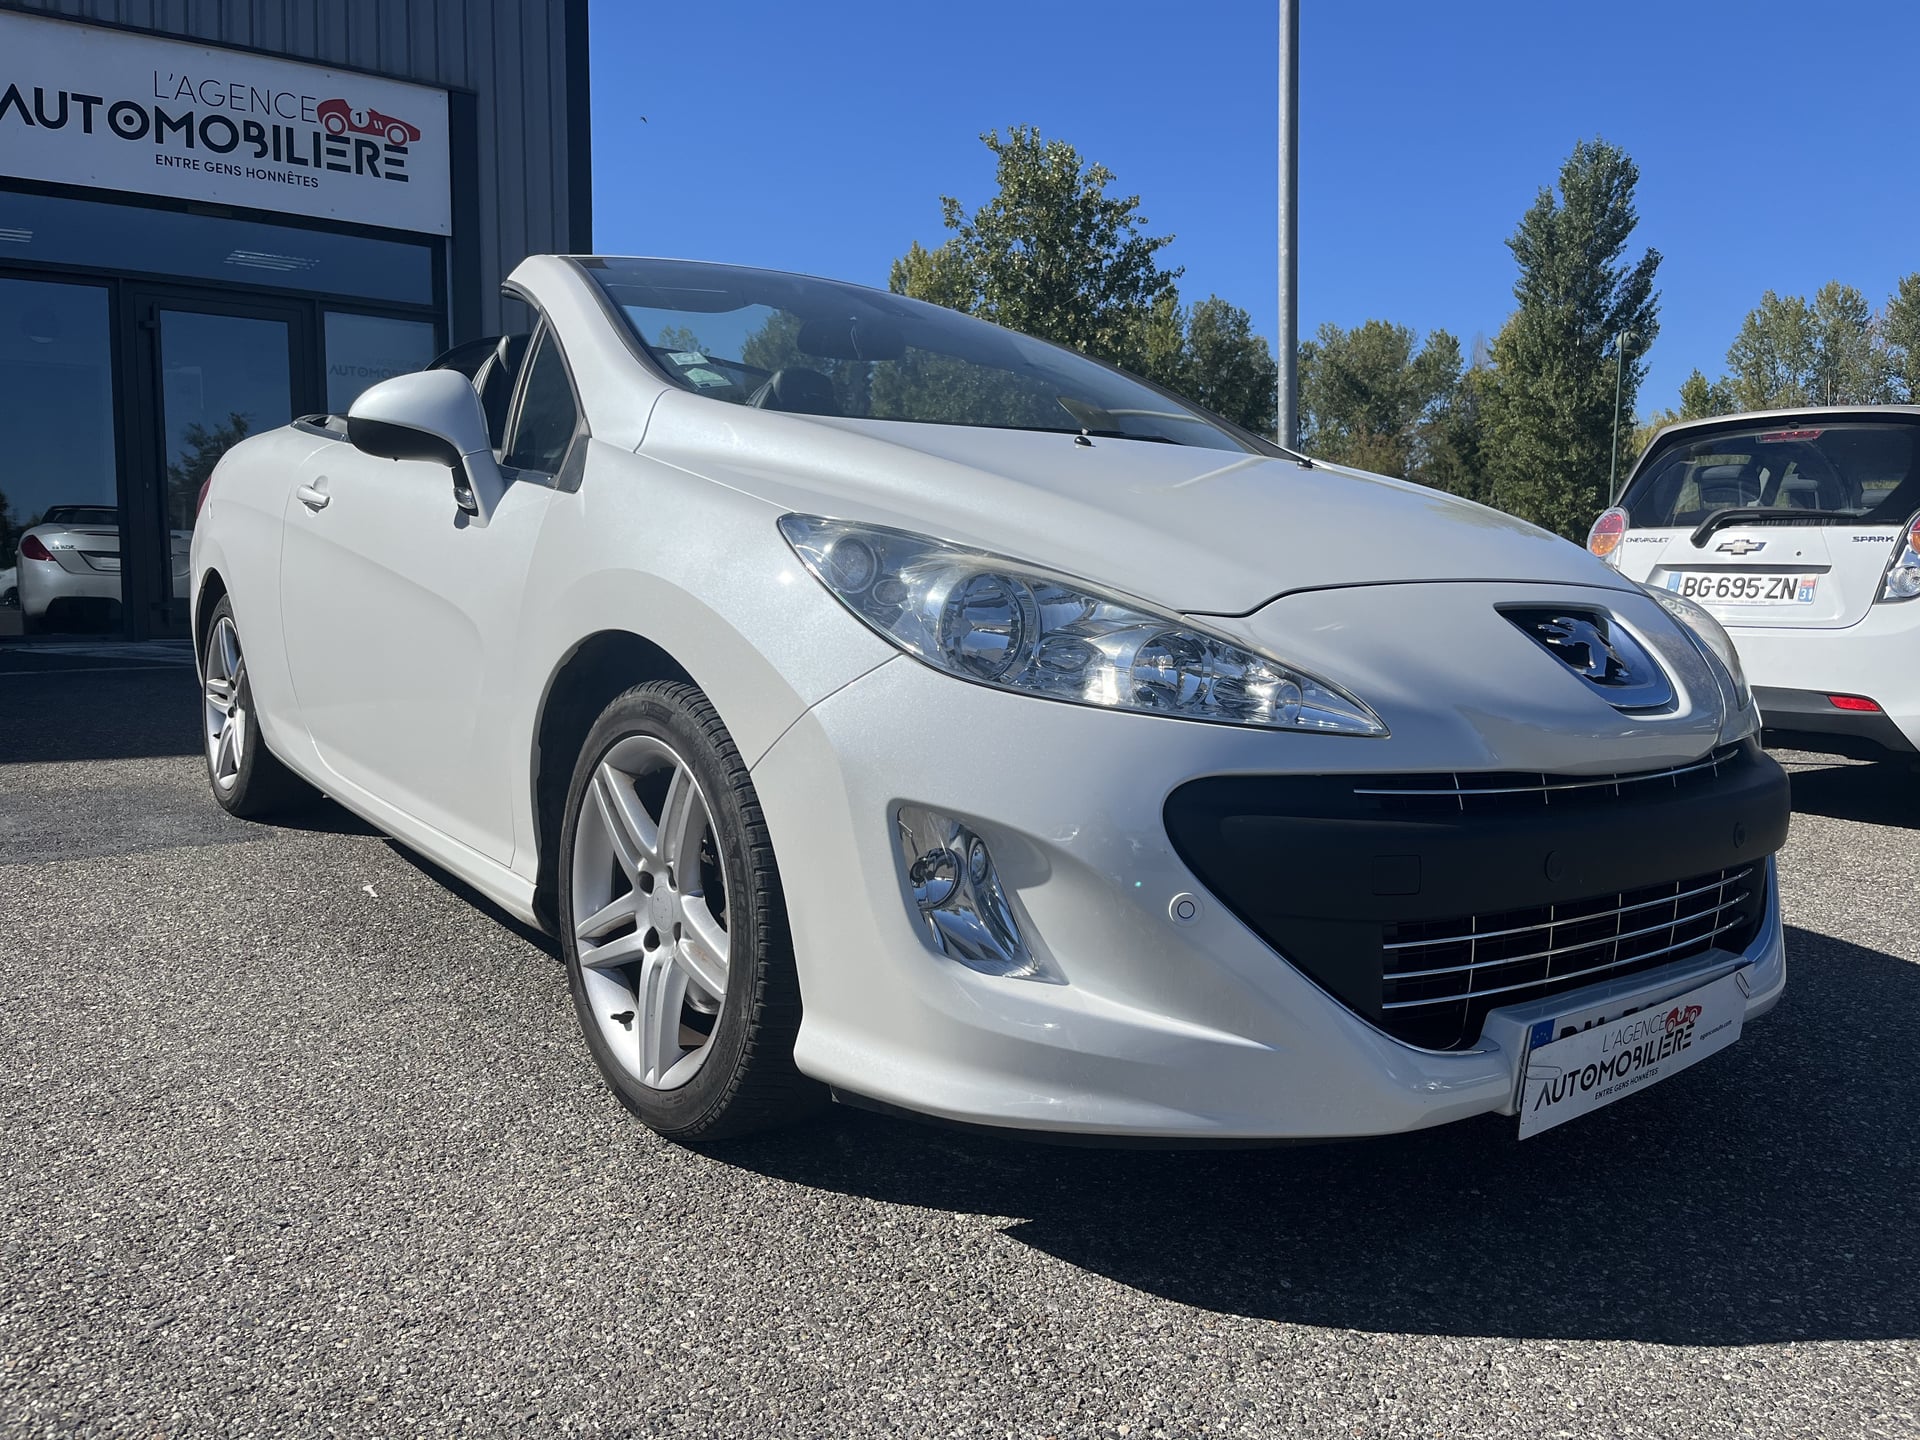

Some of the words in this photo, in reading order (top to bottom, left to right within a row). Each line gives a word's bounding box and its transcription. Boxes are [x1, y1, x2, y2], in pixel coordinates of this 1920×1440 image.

[153, 69, 318, 124] L'AGENCE
[355, 112, 363, 124] 1
[155, 154, 200, 170] ENTRE
[204, 161, 241, 177] GENS
[245, 166, 319, 188] HONNÊTES
[1625, 536, 1669, 544] CHEVROLET
[1851, 535, 1895, 543] SPARK
[1683, 577, 1799, 600] BG-695-ZN
[1800, 588, 1813, 600] 31
[1602, 1011, 1667, 1052] L'AGENCE
[1594, 1086, 1613, 1100] ENTRE
[1614, 1080, 1630, 1093] GENS
